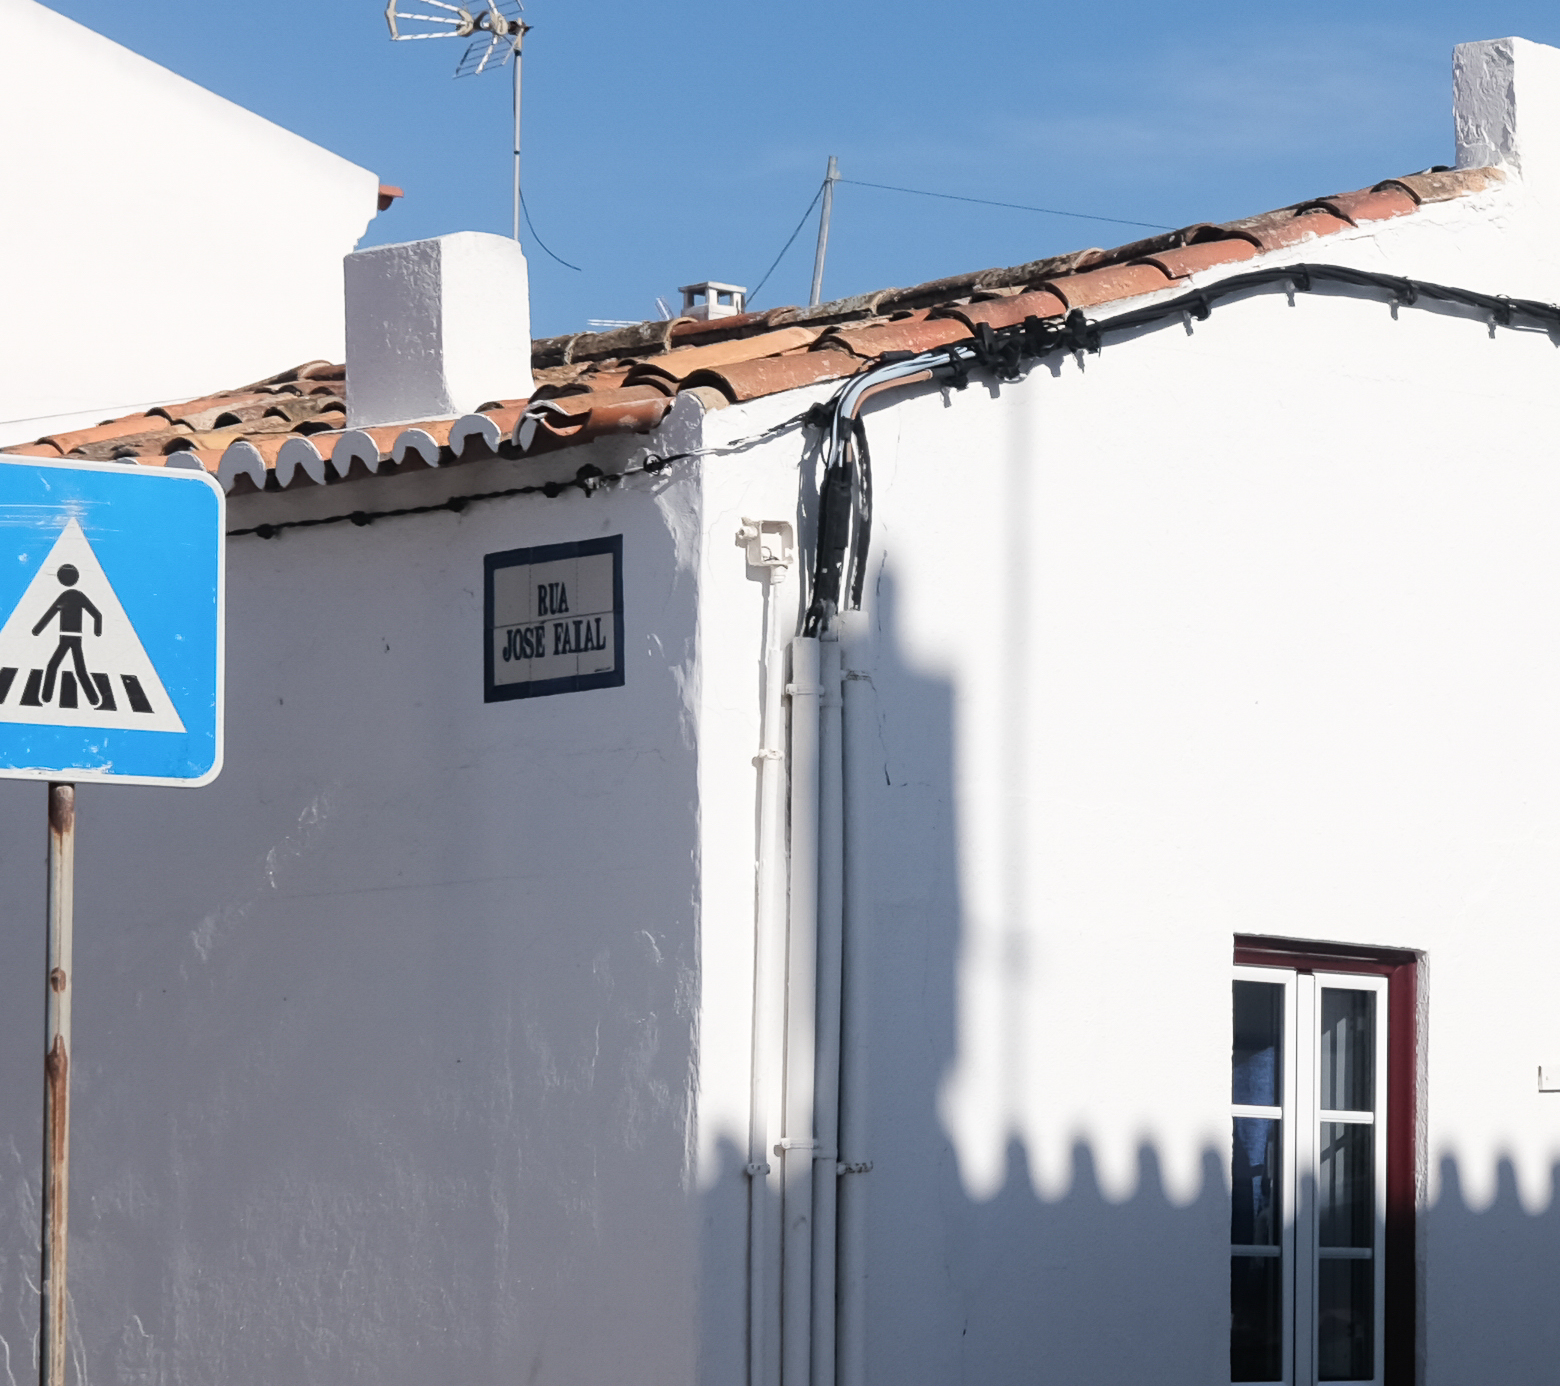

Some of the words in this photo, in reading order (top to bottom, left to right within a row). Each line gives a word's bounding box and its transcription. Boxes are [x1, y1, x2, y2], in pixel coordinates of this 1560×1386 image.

[537, 581, 569, 616] RUA
[502, 620, 545, 663] JOSÉ
[553, 617, 607, 656] FAIAL
